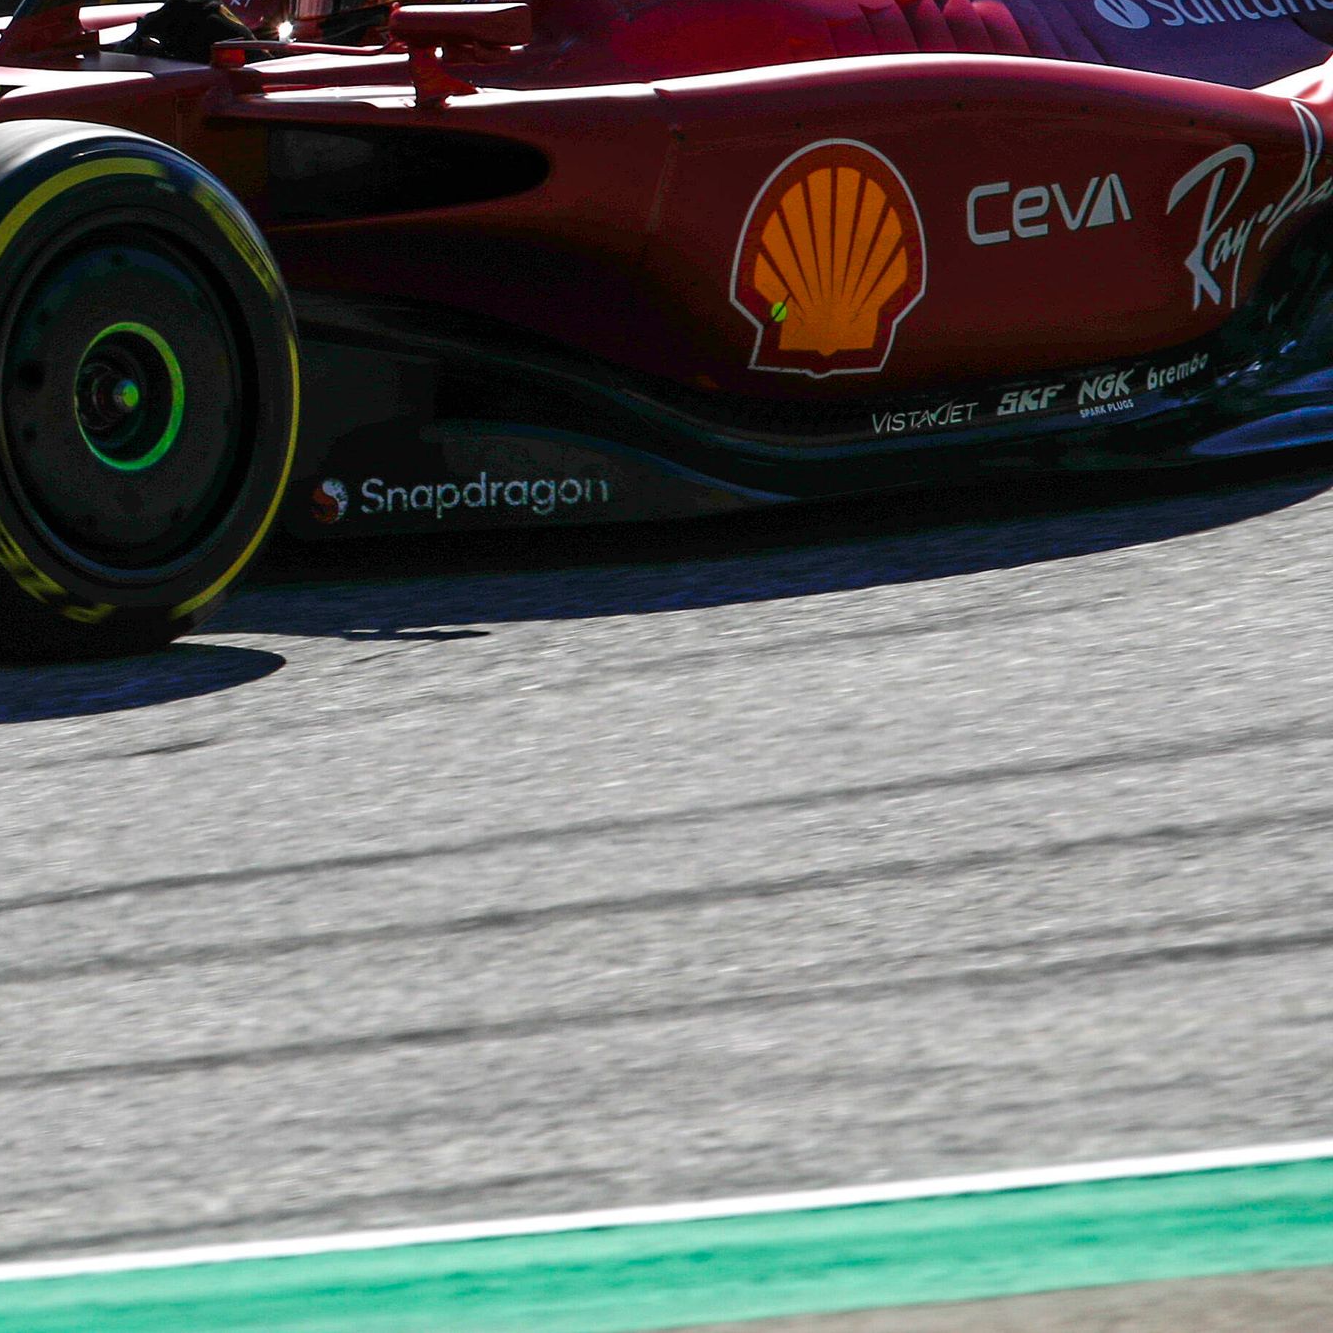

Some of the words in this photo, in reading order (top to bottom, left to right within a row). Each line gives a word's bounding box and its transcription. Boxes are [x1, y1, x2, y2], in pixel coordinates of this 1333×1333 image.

[1166, 99, 1333, 312] Ray-Ba
[1077, 368, 1135, 405] NGK
[1146, 352, 1209, 391] brembo
[996, 384, 1067, 417] SKF
[1079, 404, 1107, 418] SPARK
[1107, 398, 1135, 414] PLUGS
[360, 471, 610, 518] Snapdragon
